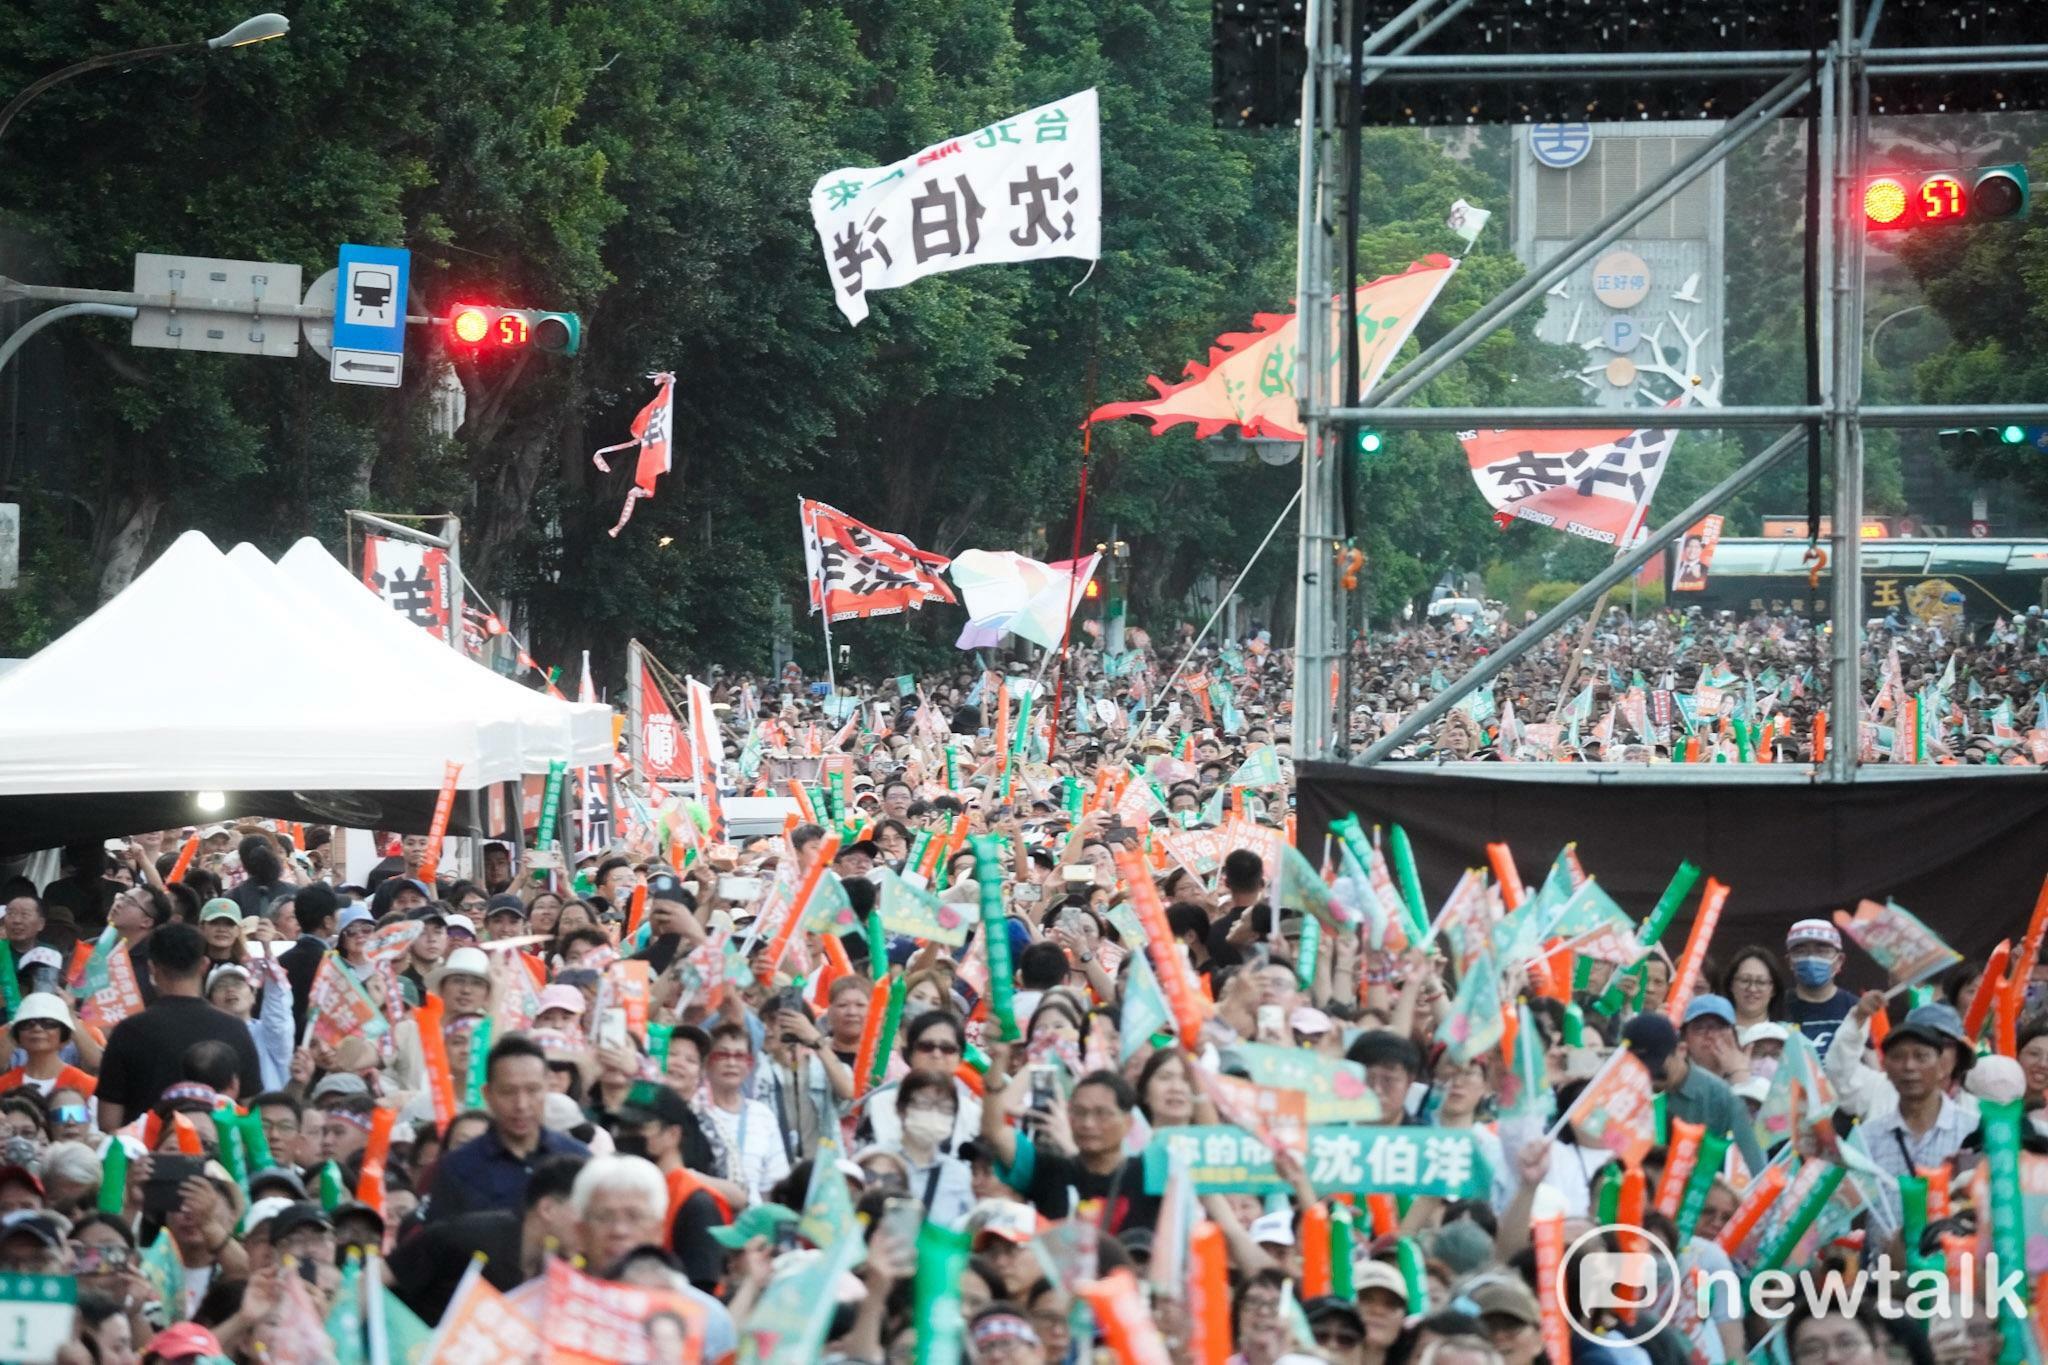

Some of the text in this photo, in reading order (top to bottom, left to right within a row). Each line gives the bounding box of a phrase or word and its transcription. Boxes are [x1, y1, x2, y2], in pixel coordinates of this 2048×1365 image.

[1922, 180, 1960, 218] 57
[1596, 274, 1646, 292] 正好停
[500, 316, 527, 344] 57
[1613, 321, 1632, 347] P
[1310, 1133, 1474, 1187] 沈伯洋
